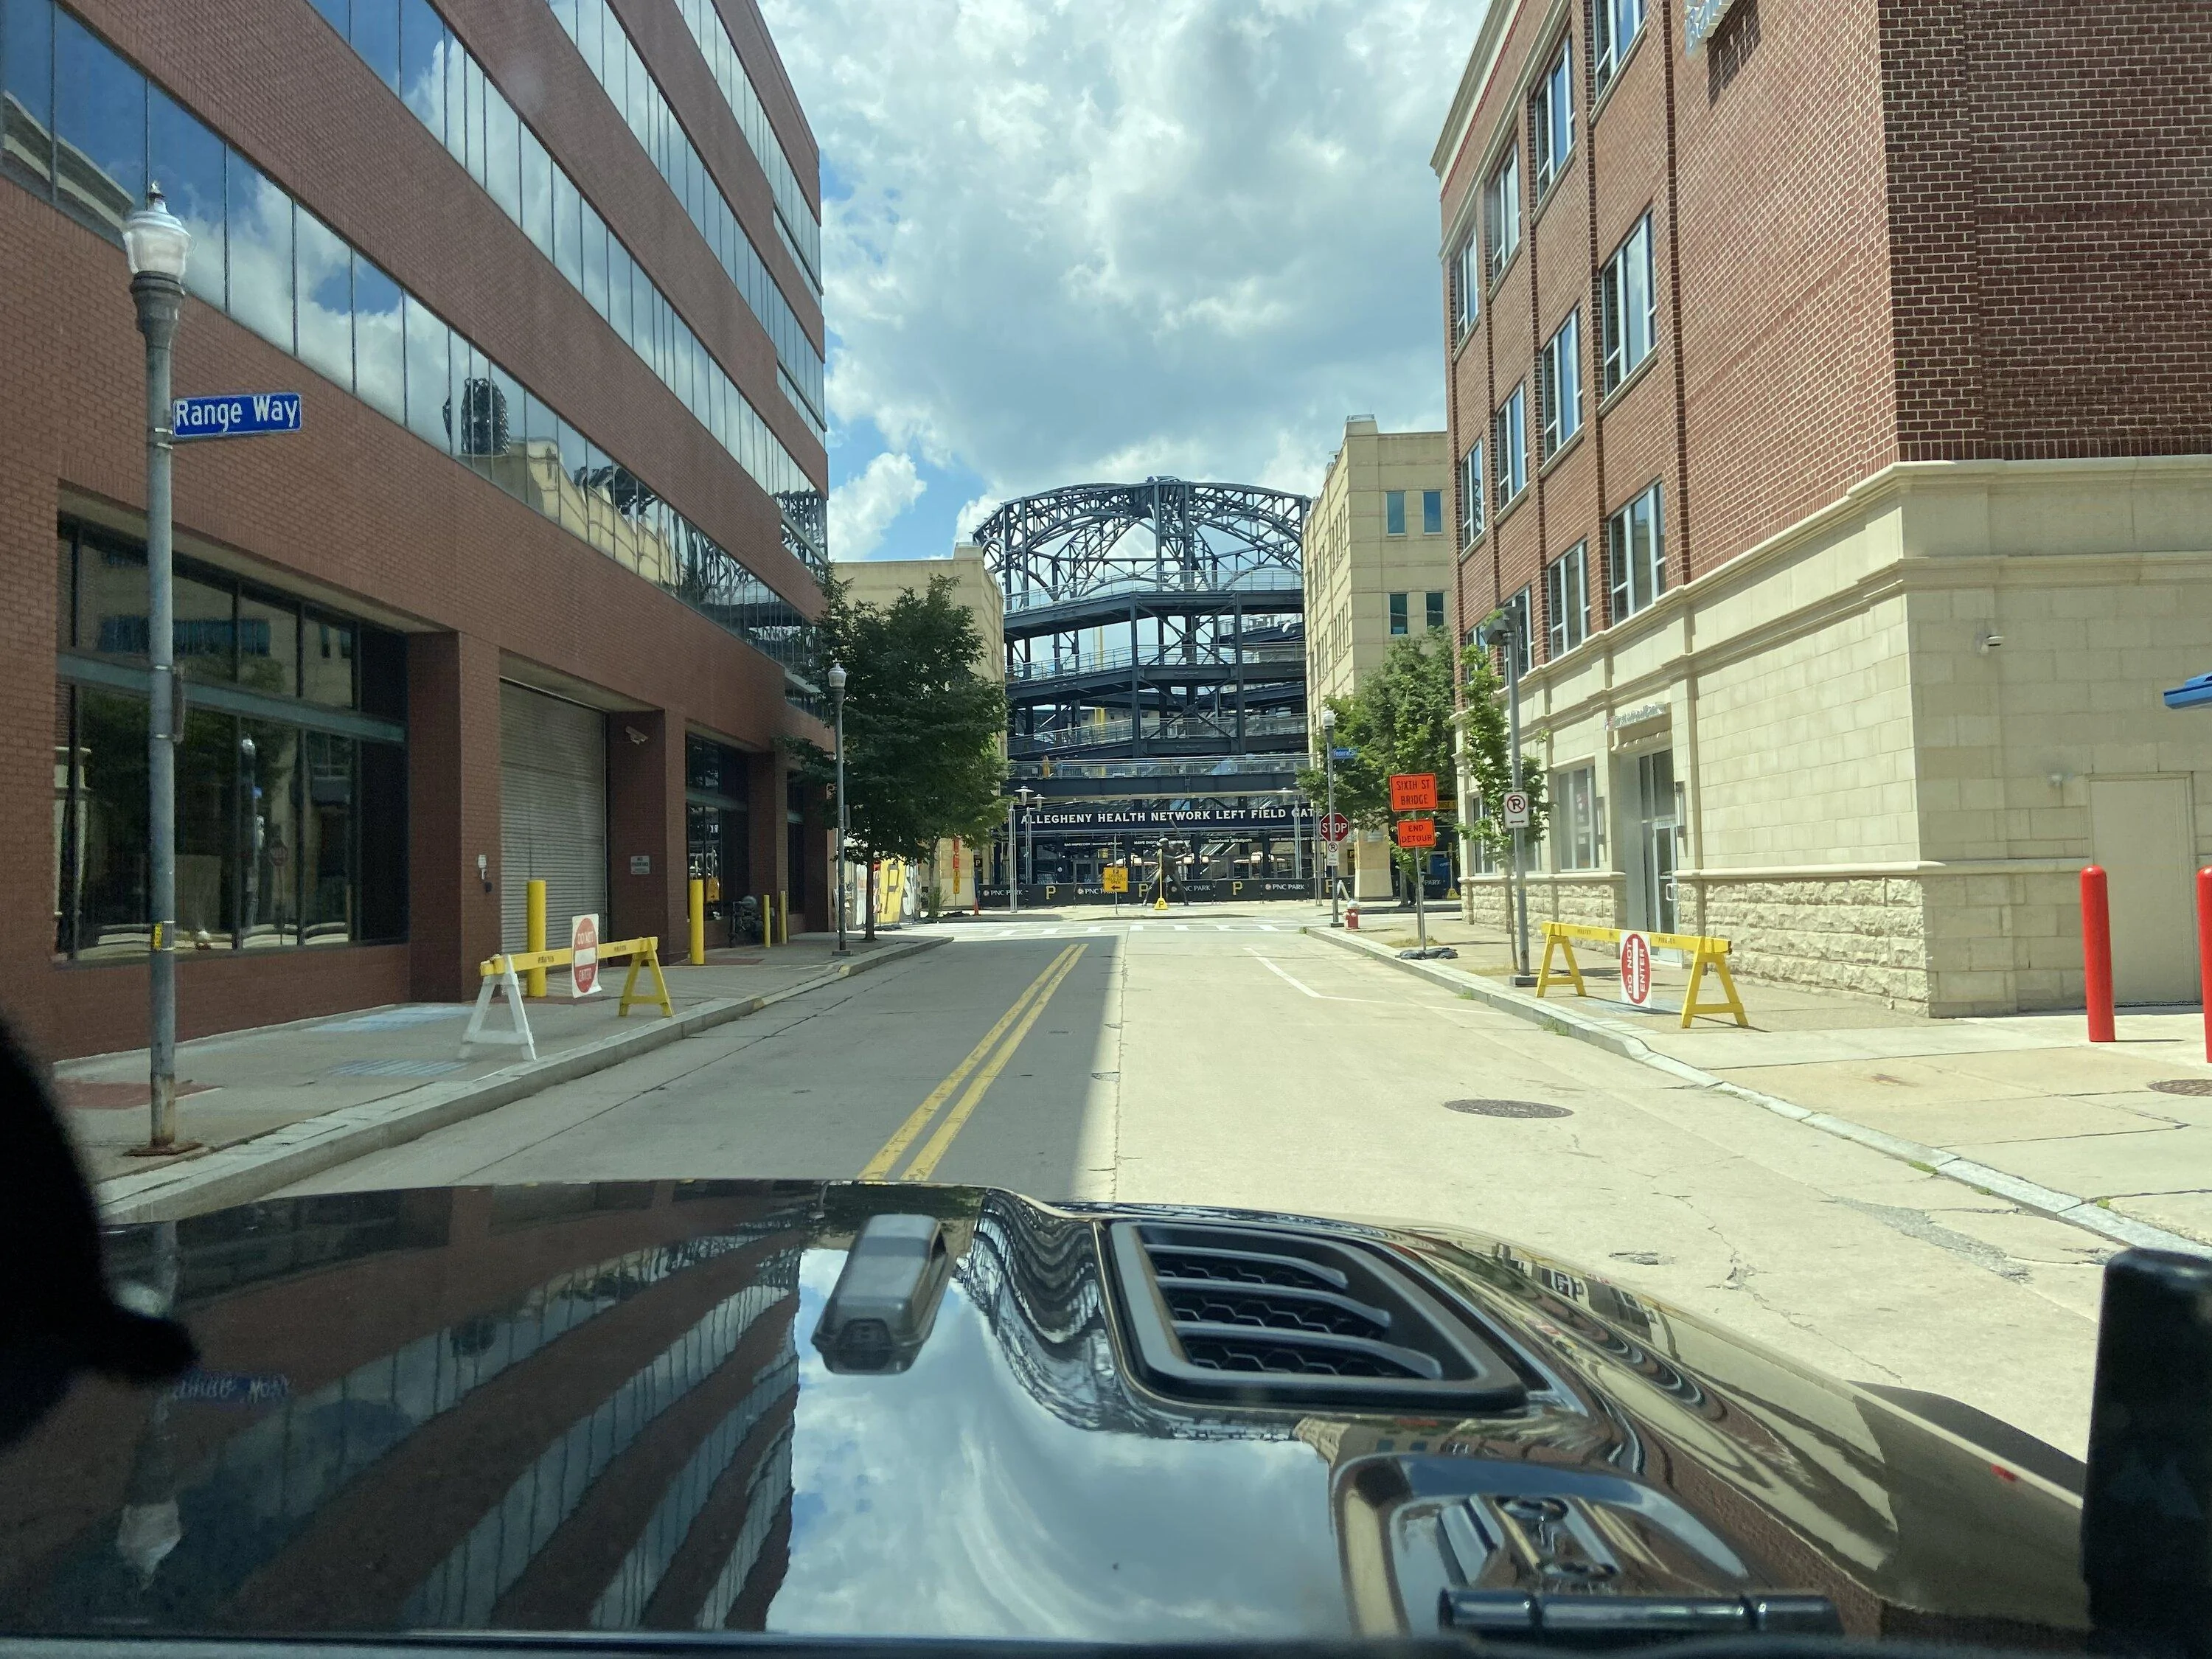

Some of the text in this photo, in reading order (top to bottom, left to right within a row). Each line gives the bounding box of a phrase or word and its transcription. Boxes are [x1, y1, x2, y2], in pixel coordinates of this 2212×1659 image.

[175, 395, 298, 432] Range Way
[1396, 779, 1430, 791] SIXTH ST
[1401, 794, 1428, 805] BRIDGE
[1020, 813, 1092, 824] ALLEGHENY
[1098, 813, 1146, 822] HEALTH
[1151, 810, 1211, 821] NETWORK
[1216, 810, 1246, 820] LEFT
[1251, 809, 1286, 819] FIELD
[1322, 822, 1347, 833] SOP
[1408, 824, 1423, 832] END
[1402, 835, 1432, 844] DETOUR
[1046, 885, 1057, 900] P
[1232, 880, 1243, 896] P
[1627, 974, 1632, 994] DO
